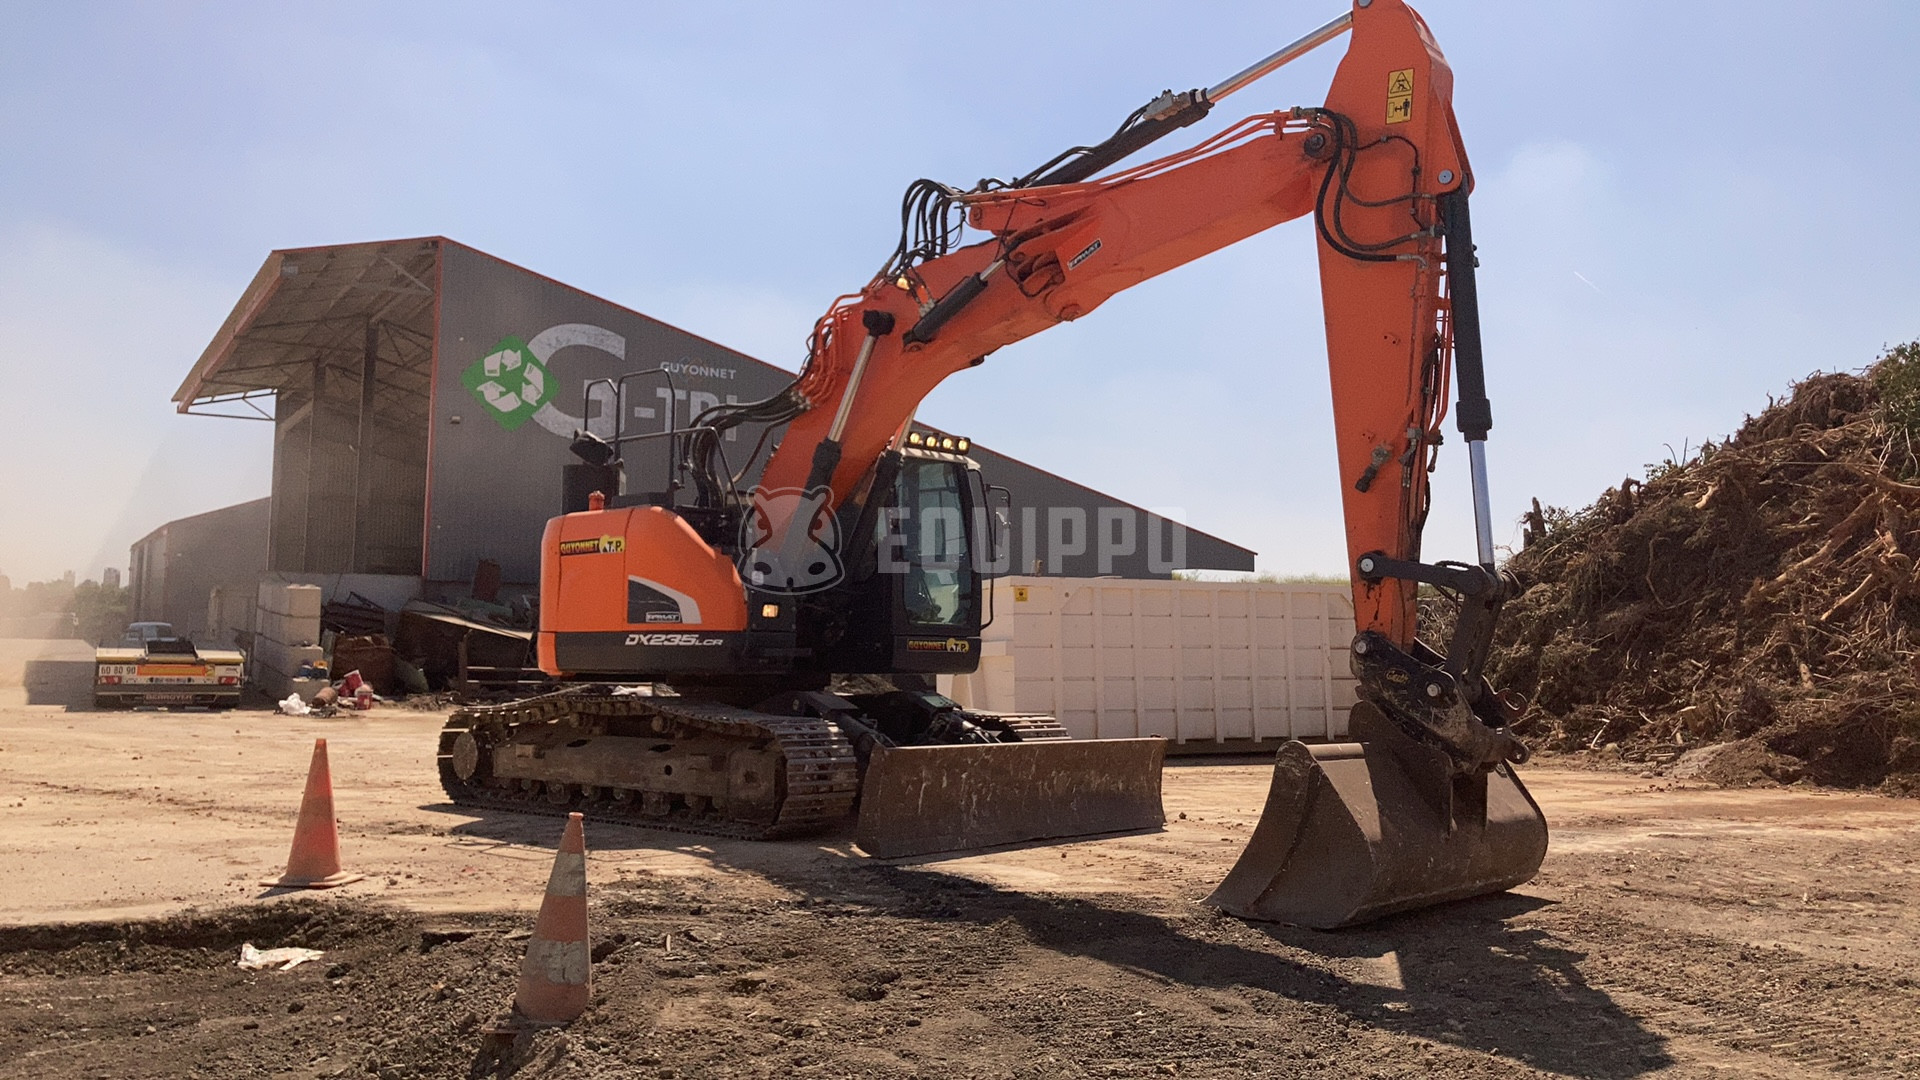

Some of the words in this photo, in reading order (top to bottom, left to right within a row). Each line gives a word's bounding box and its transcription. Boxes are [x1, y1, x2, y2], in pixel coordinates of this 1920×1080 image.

[660, 361, 737, 380] GUYONNET
[560, 540, 600, 554] GUYONNET
[908, 640, 946, 650] GUYONNET
[101, 666, 111, 674] 60
[114, 666, 123, 674] 80
[126, 666, 136, 675] 90
